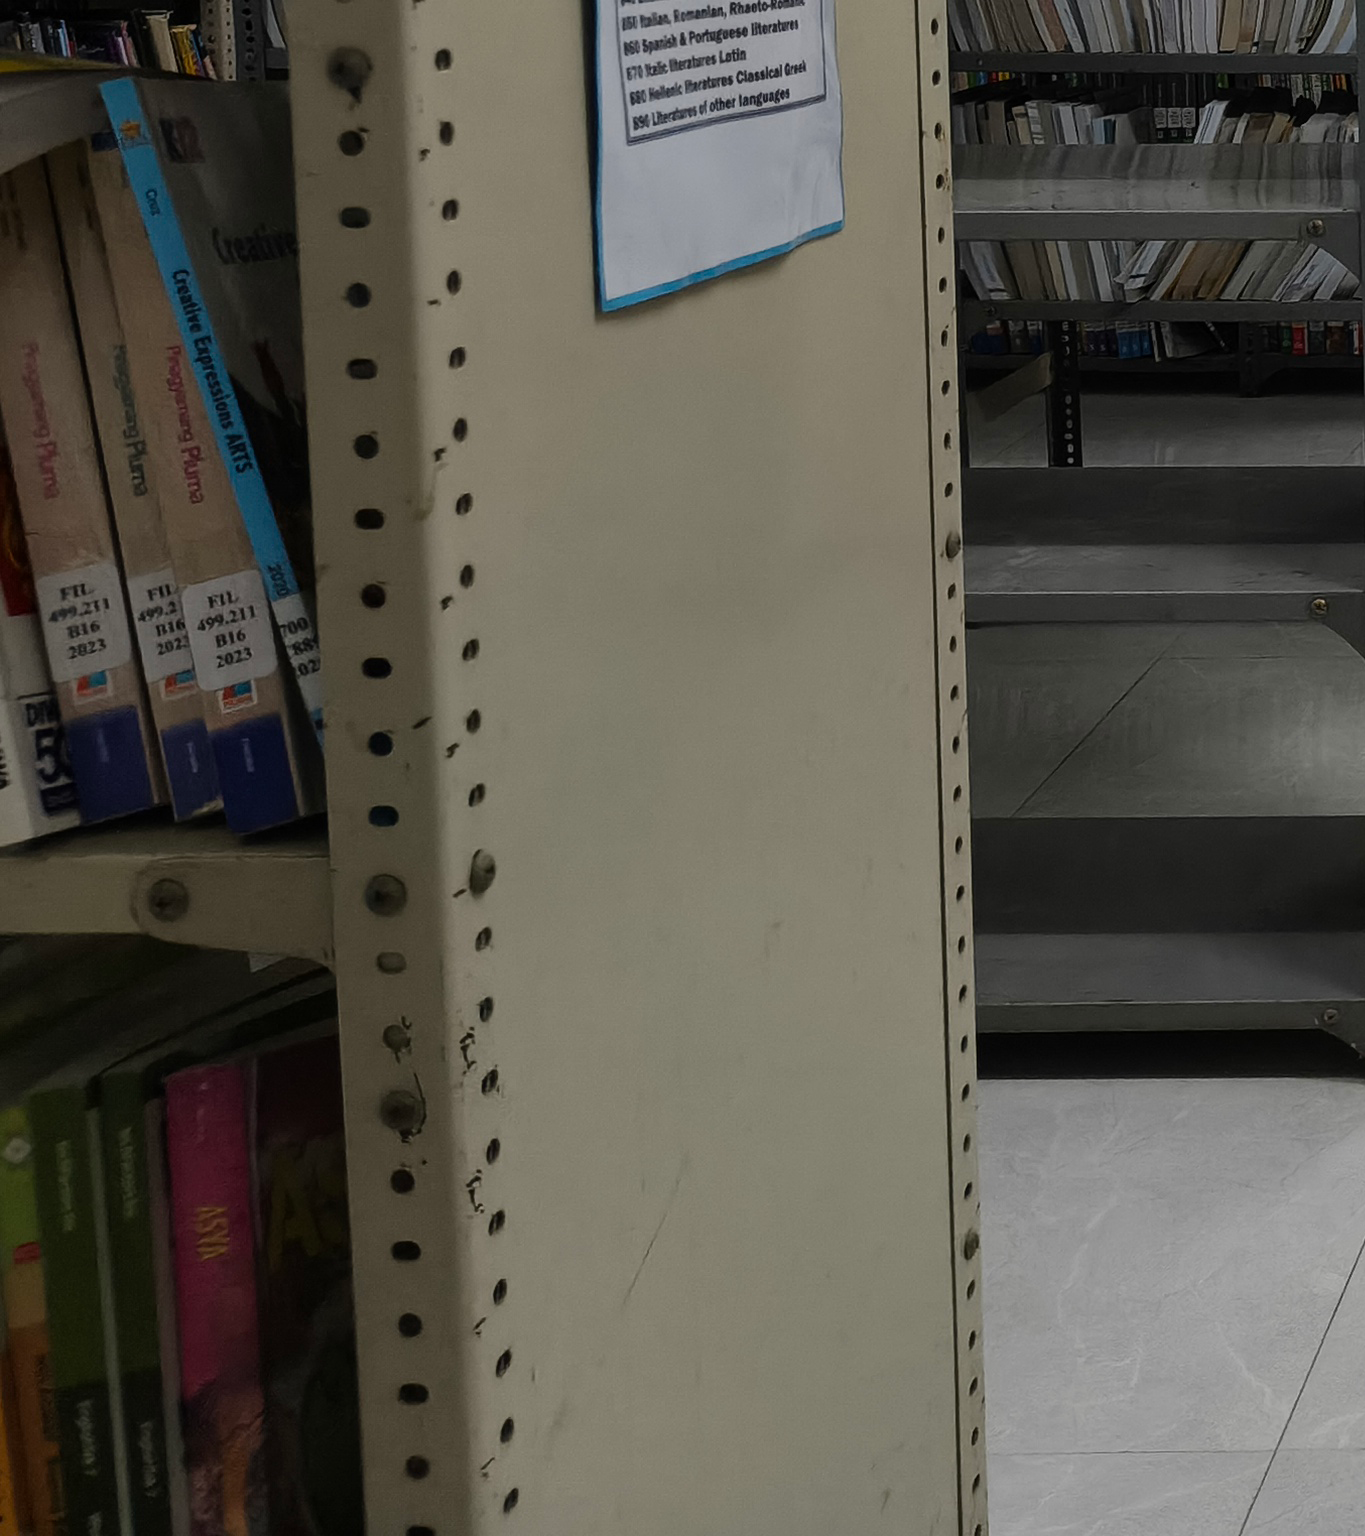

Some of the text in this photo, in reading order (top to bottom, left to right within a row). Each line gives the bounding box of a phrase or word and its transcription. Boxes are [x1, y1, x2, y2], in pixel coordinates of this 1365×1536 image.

[643, 18, 799, 53] Spanish & Portuguese literatures
[719, 48, 746, 64] Latin
[736, 65, 782, 84] Classical
[709, 87, 790, 113] other languages
[172, 267, 254, 474] Creative Expressions ARTS
[125, 439, 149, 498] Pluma
[181, 445, 204, 505] Pluma
[59, 582, 95, 600] FIL
[207, 590, 241, 610] FIL
[197, 605, 256, 632] 499.211
[66, 620, 101, 639] B16
[215, 630, 247, 649] B16
[215, 648, 253, 669] 2023
